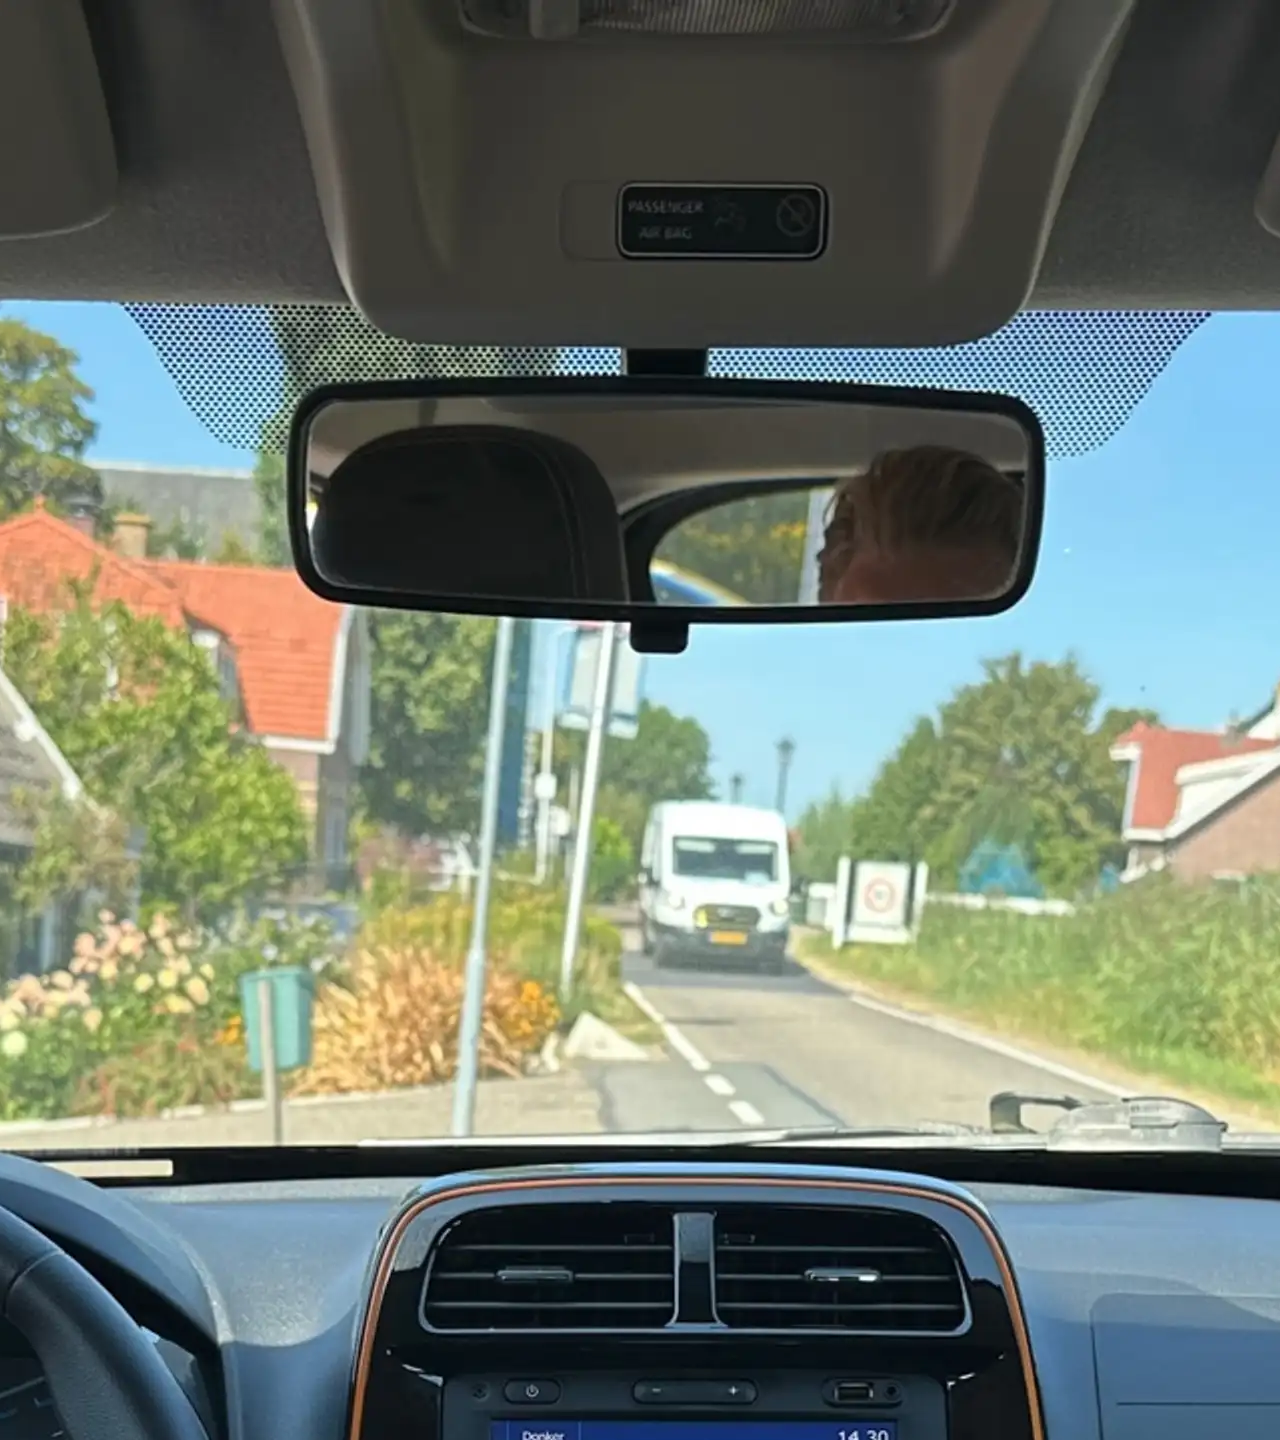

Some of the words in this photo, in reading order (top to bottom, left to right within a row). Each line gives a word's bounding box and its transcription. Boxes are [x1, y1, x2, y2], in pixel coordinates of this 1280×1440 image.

[627, 199, 704, 214] PASSENGER
[639, 226, 660, 239] AIR
[664, 226, 693, 239] BAG
